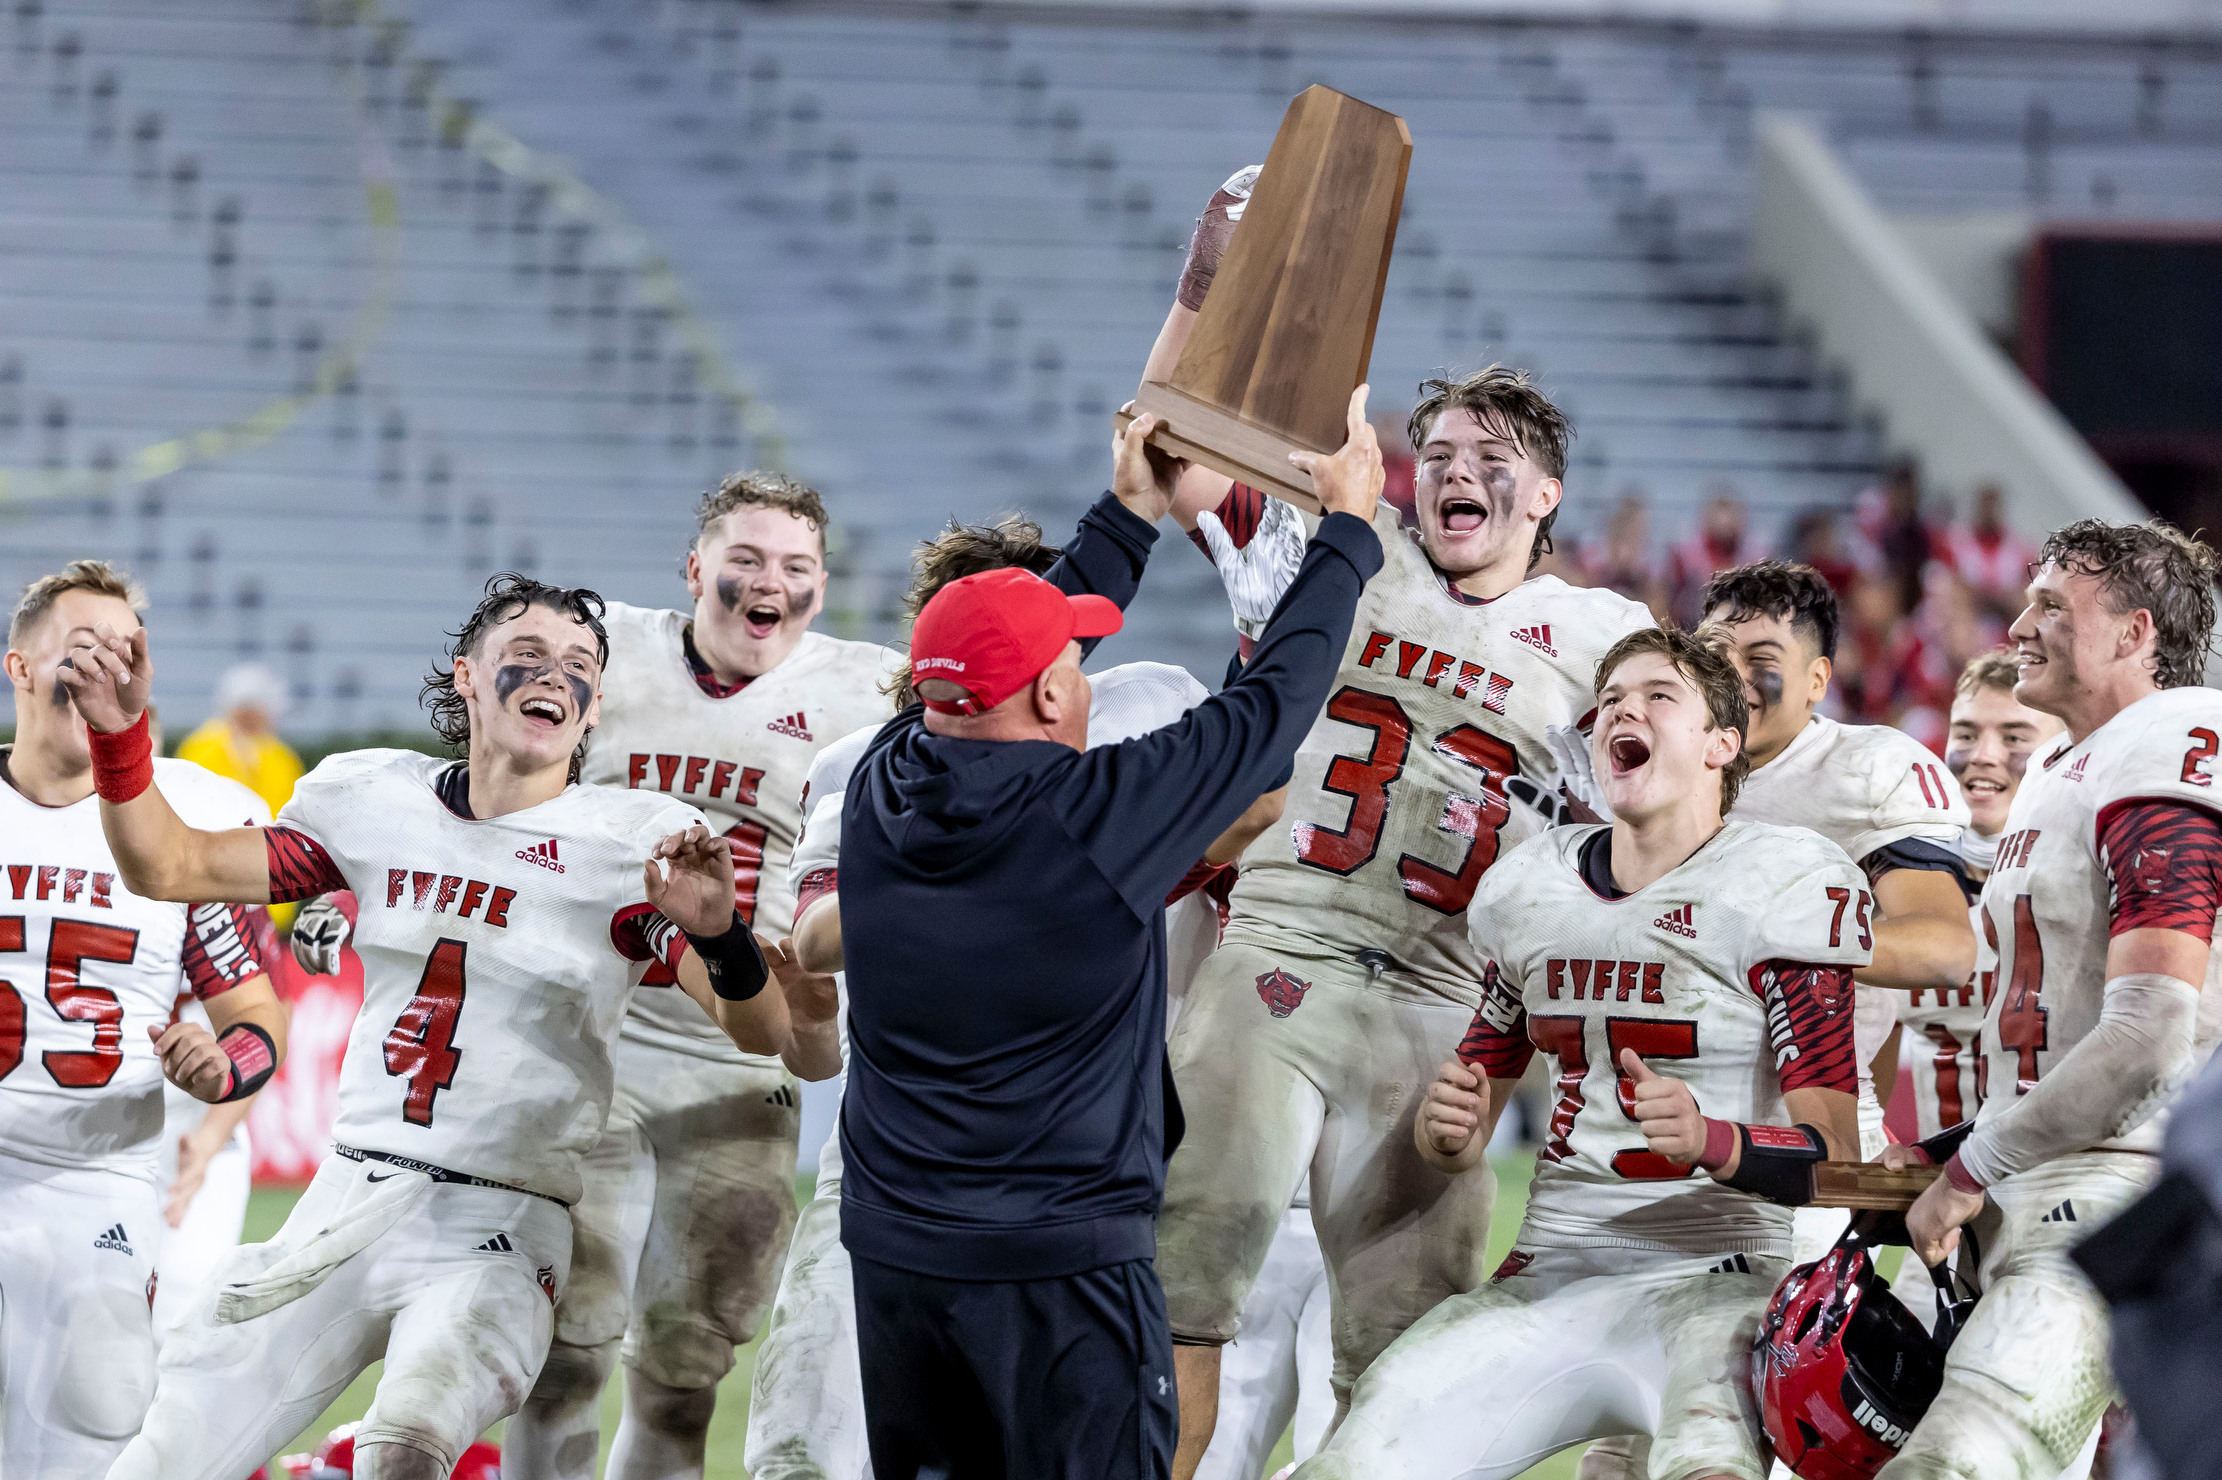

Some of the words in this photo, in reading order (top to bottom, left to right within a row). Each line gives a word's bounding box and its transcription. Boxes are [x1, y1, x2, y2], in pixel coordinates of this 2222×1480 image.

[931, 657, 966, 672] DEVILS
[1509, 627, 1559, 659] adidas
[1358, 631, 1514, 716] FYFFE
[766, 721, 814, 743] adidas
[628, 753, 767, 808] FYFFE
[1290, 684, 1520, 917] 33
[1911, 762, 1950, 810] 11
[515, 850, 566, 875] adidas
[0, 864, 116, 909] YFFE
[386, 868, 517, 929] FYFFE
[1654, 917, 1698, 939] adidas
[1825, 886, 1874, 952] 75
[1546, 958, 1666, 1005] FYFFE
[382, 937, 468, 1129] 4
[1527, 1013, 1700, 1180] 75
[94, 1239, 134, 1257] adidas
